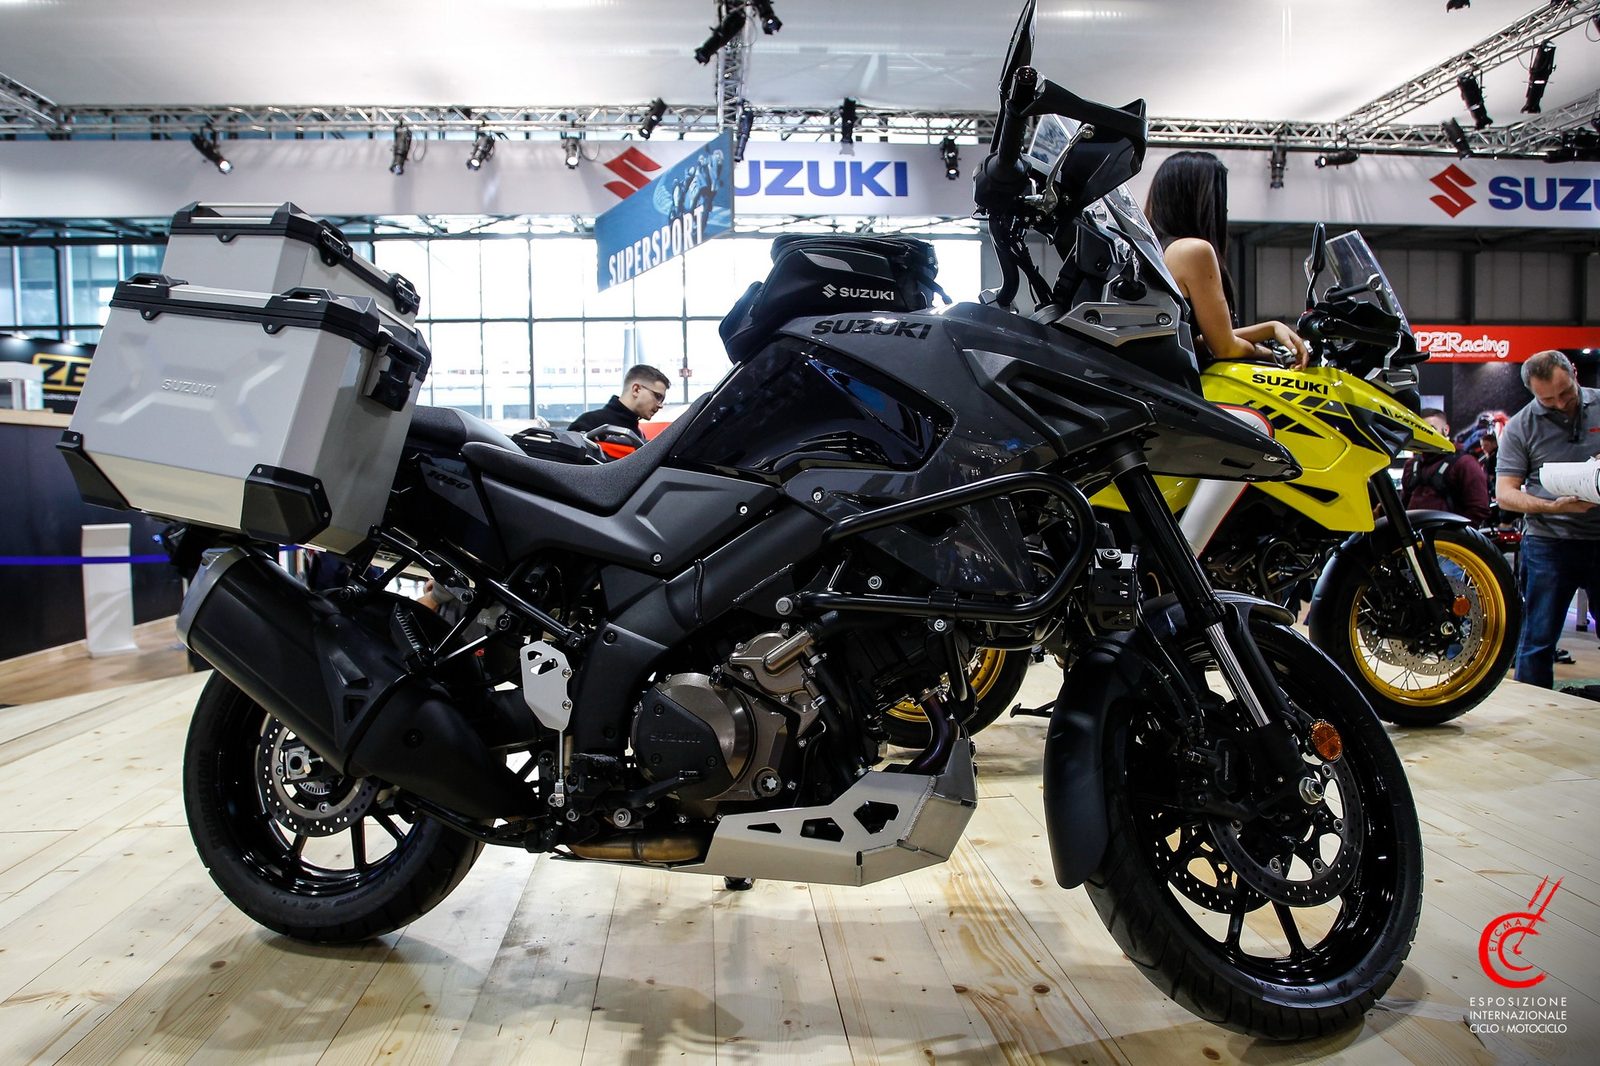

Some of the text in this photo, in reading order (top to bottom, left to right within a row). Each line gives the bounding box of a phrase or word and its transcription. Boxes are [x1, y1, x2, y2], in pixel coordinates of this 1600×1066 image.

[734, 160, 908, 197] UZUKI
[1488, 176, 1600, 211] SUZ
[608, 204, 705, 287] SUPERSPORT
[839, 287, 895, 301] SUZUKI
[811, 319, 933, 340] SUZUKI
[160, 377, 217, 398] SUZUKI
[1252, 373, 1329, 396] SUZUKI
